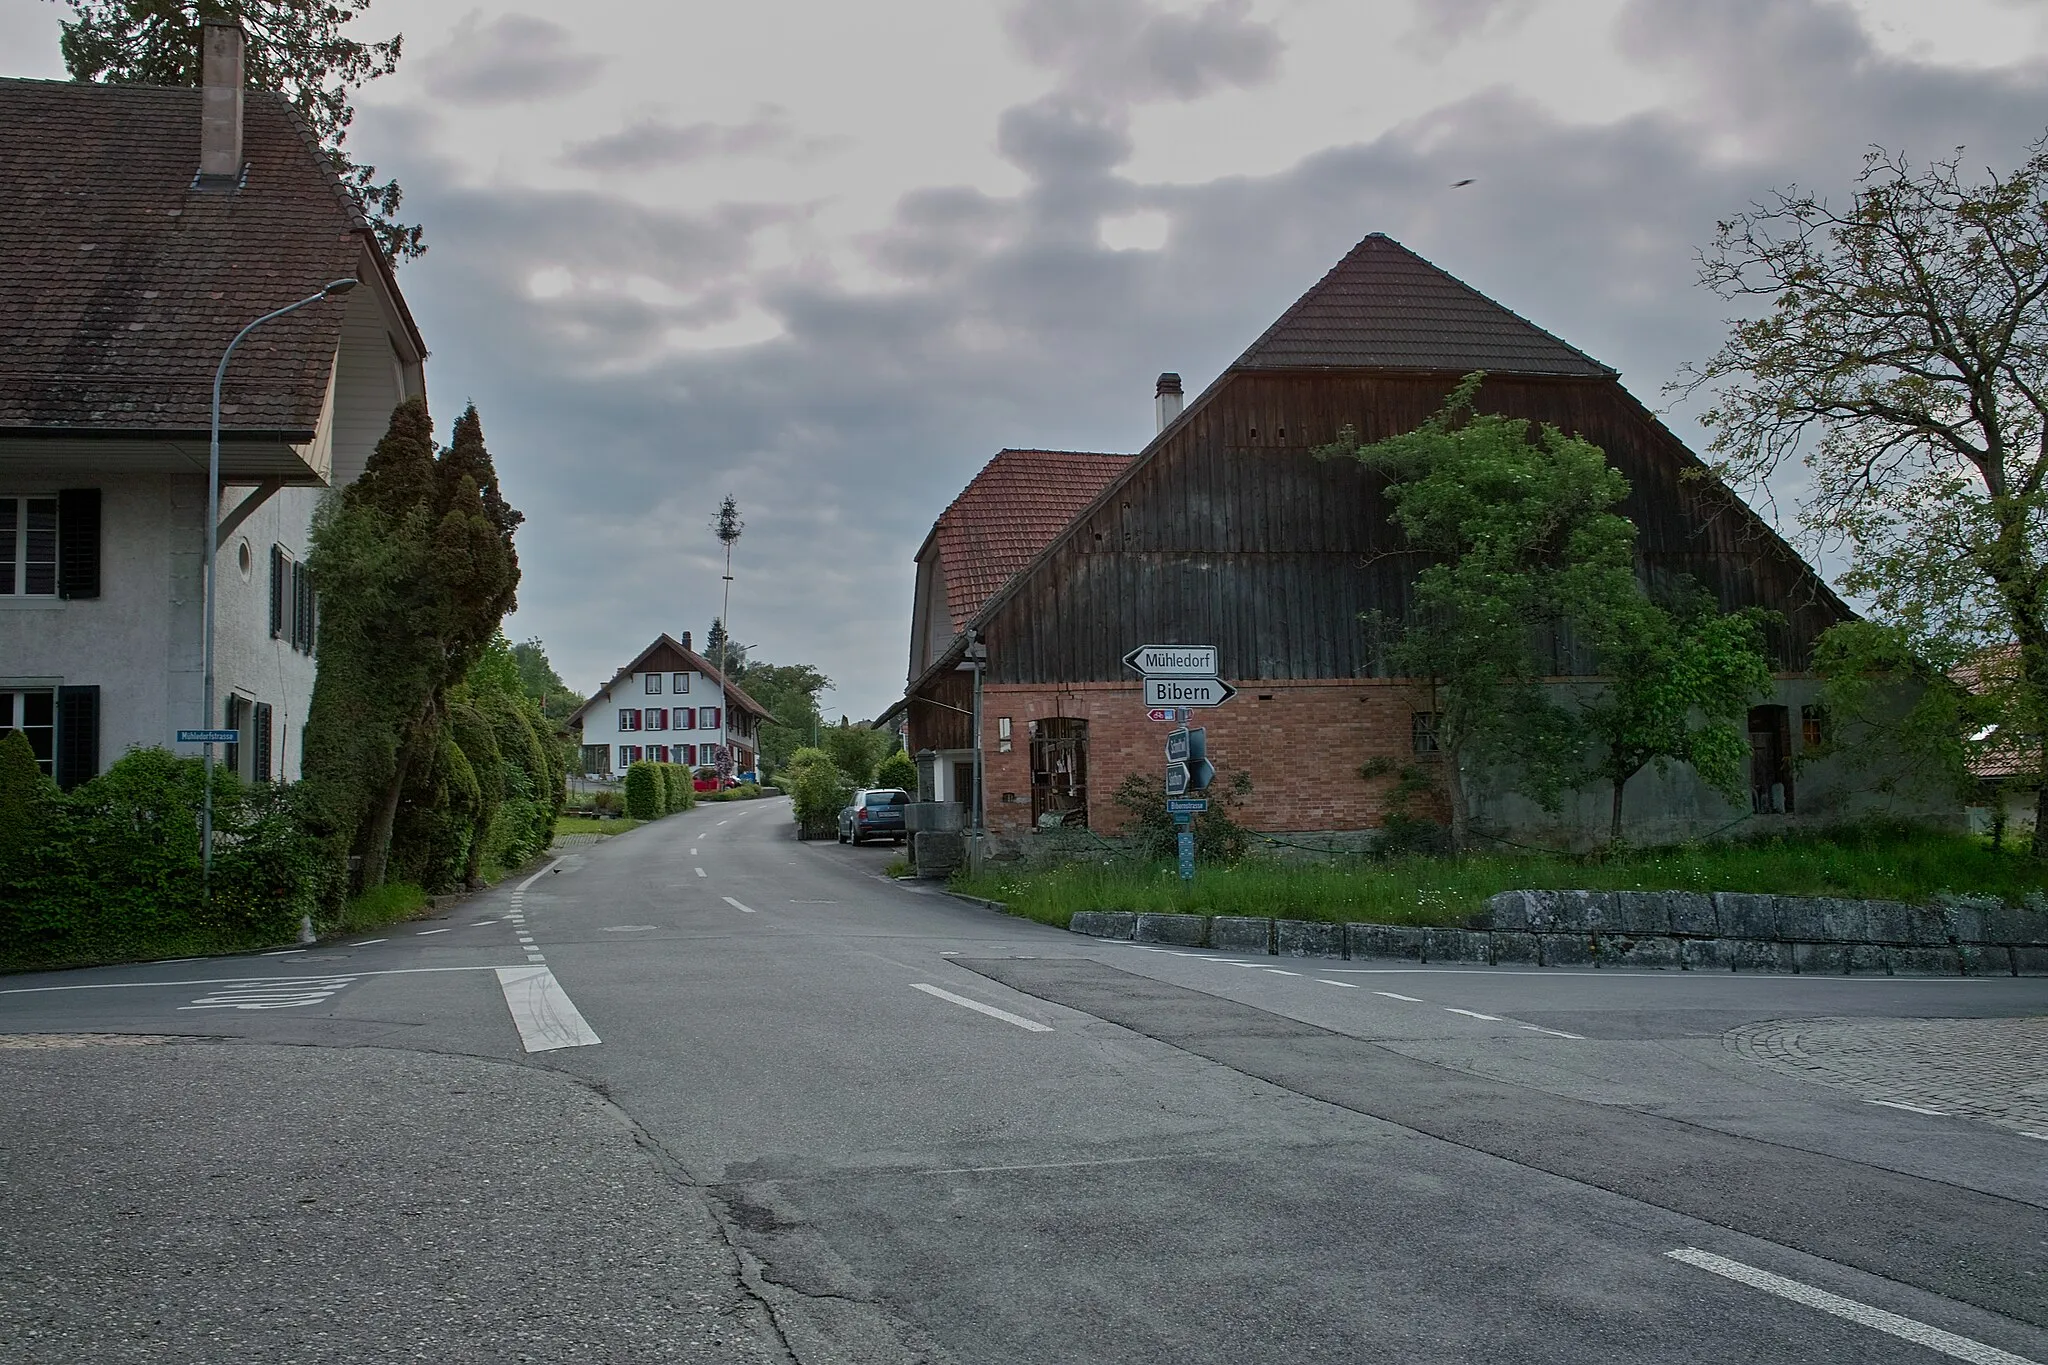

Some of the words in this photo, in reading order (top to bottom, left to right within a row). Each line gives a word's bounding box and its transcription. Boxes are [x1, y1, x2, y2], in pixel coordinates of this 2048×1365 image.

[1146, 653, 1210, 667] Mühledorf
[1157, 683, 1209, 700] Bibern
[181, 731, 234, 740] Mühledorfstrasse
[1171, 801, 1203, 809] Bibernstrasse
[176, 977, 358, 1009] STOP
